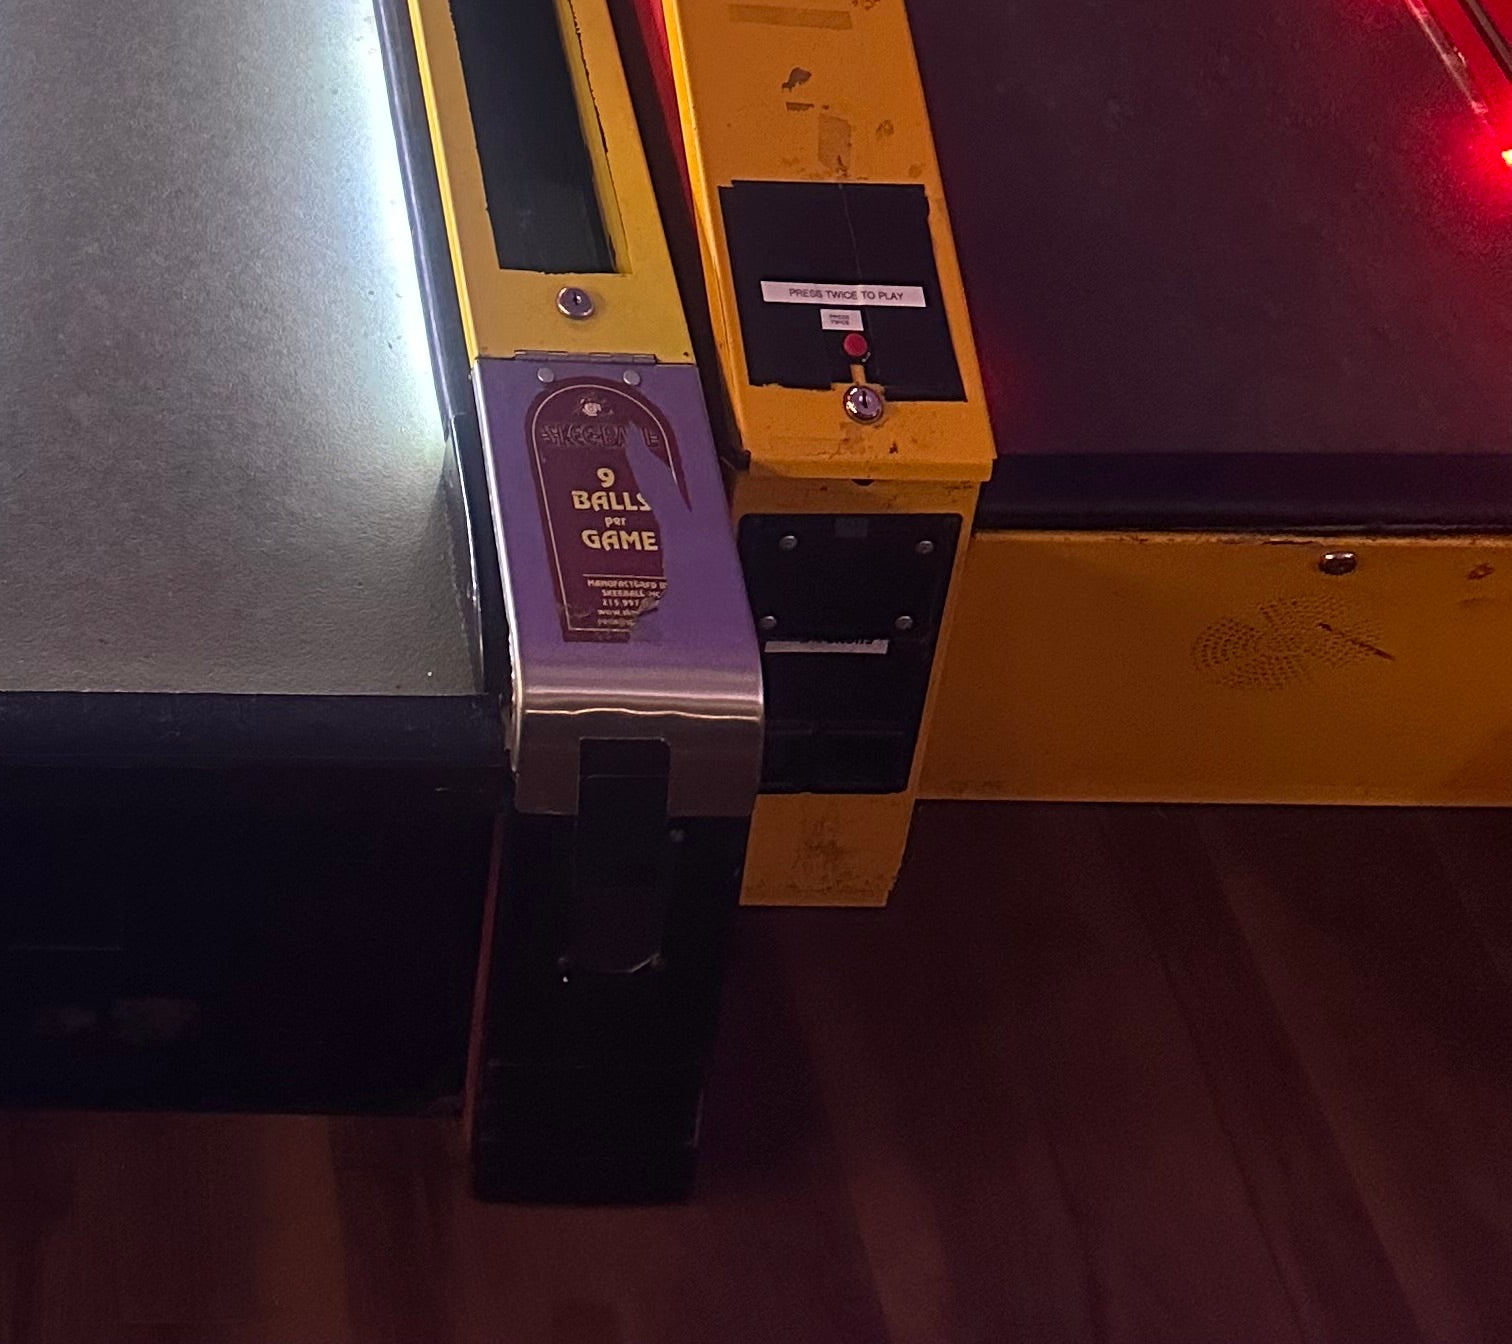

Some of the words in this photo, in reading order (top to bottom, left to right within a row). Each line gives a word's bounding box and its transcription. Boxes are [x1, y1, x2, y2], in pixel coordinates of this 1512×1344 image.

[788, 288, 823, 299] PRESS
[825, 289, 858, 300] TWICE
[861, 290, 876, 301] TO
[878, 291, 904, 301] PLAY
[596, 467, 616, 489] 9
[571, 490, 653, 512] BALLS
[604, 515, 626, 528] per
[581, 529, 659, 552] GAME
